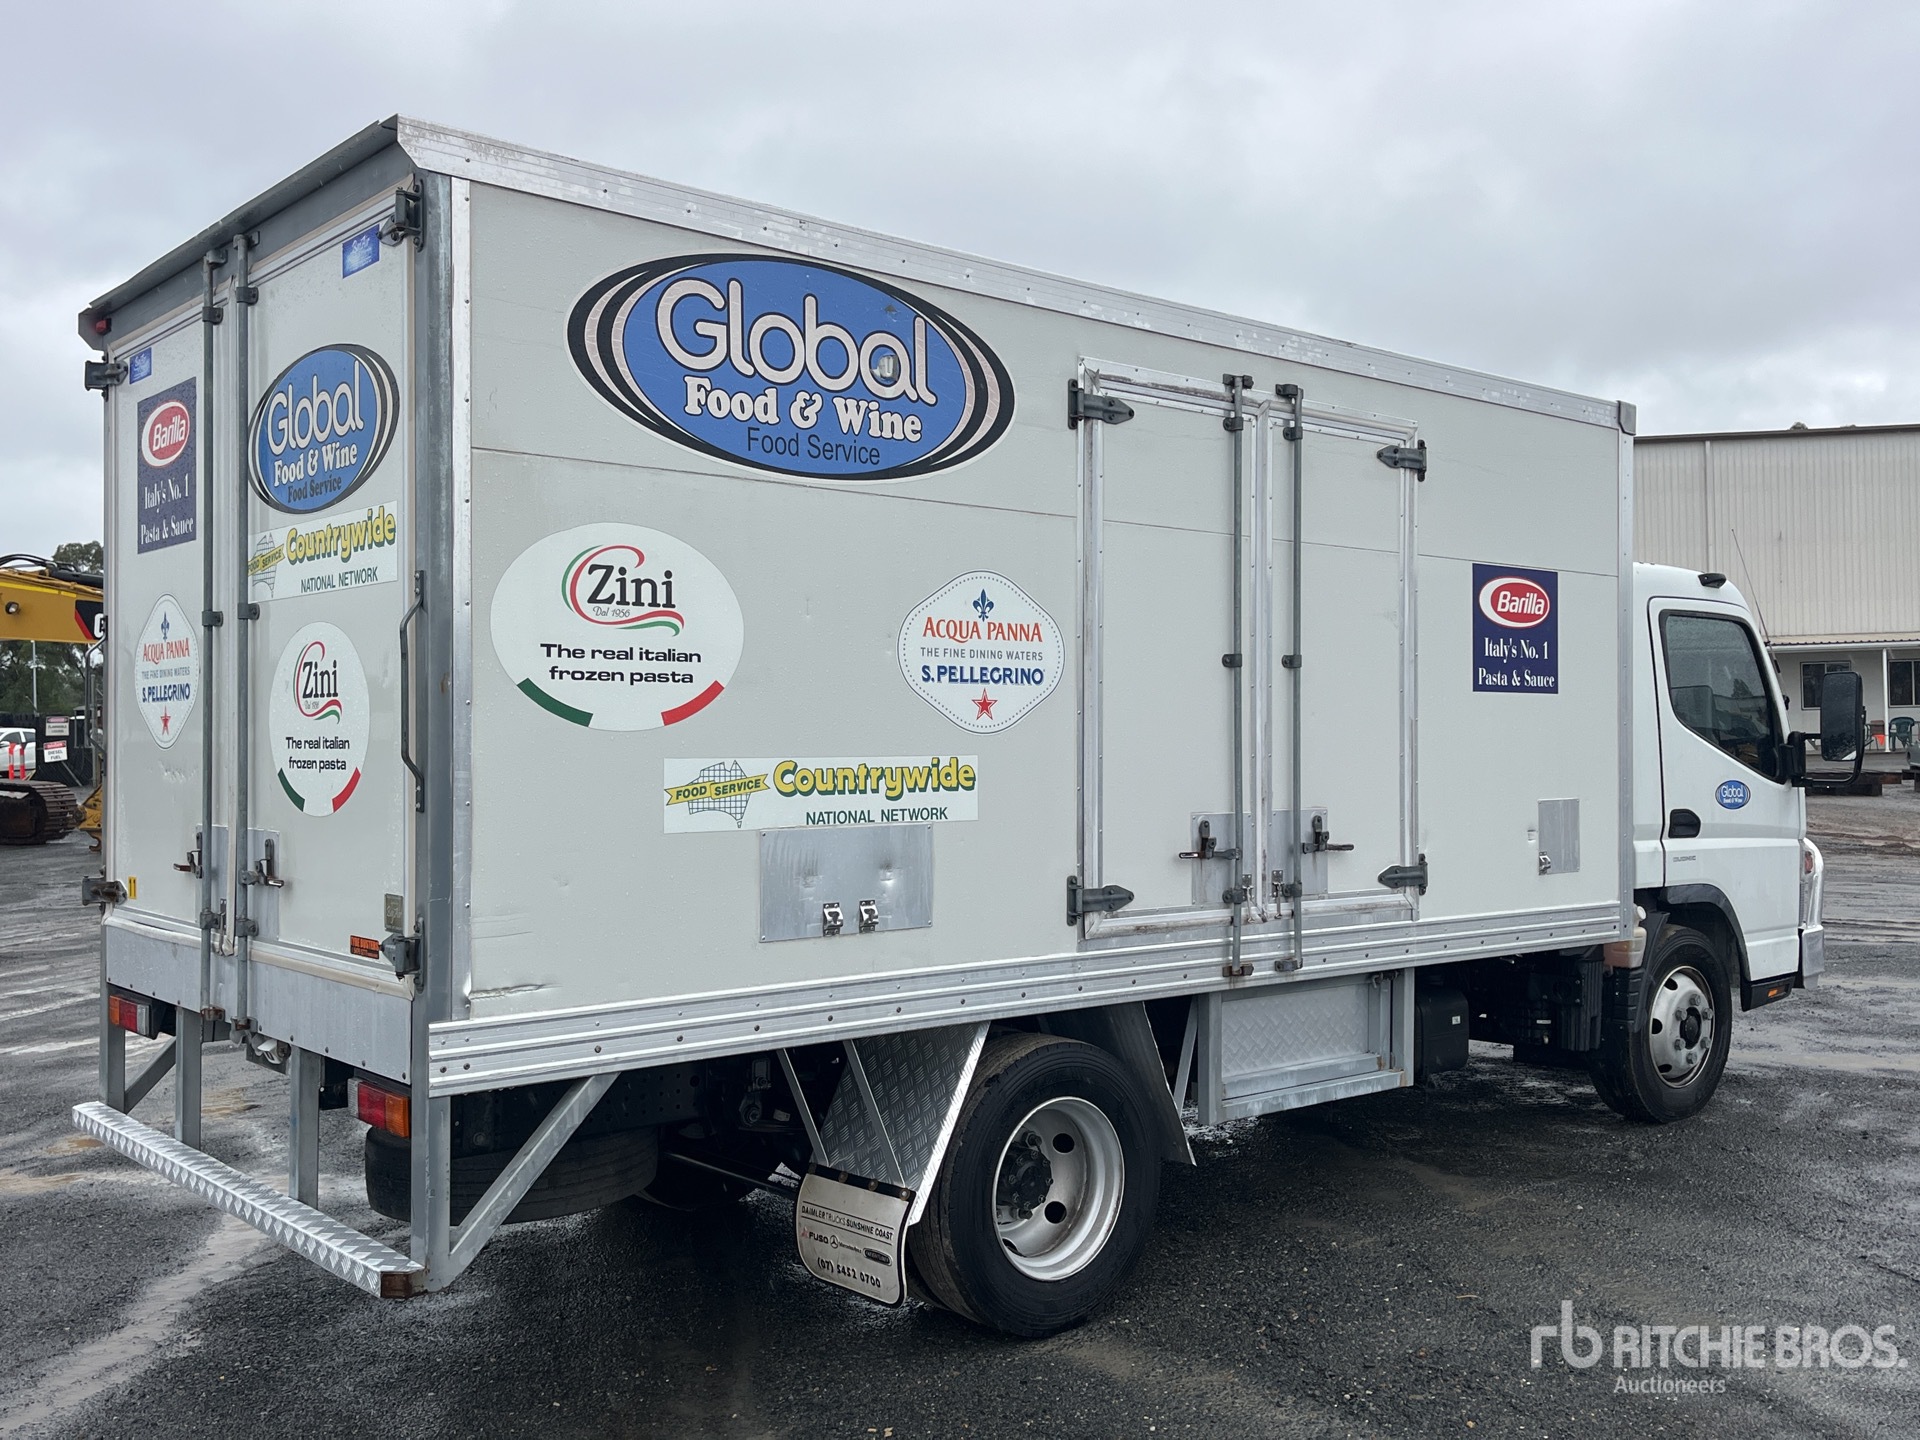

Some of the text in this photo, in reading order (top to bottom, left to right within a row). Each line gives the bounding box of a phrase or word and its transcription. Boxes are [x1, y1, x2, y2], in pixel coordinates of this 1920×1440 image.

[657, 277, 937, 405] Global
[267, 360, 364, 455] Global
[683, 375, 922, 443] Food & Wine
[153, 415, 186, 451] Barilla
[747, 426, 880, 466] Food Service
[274, 442, 357, 487] Food & Wine
[145, 473, 189, 513] Italy's No. 1
[288, 474, 342, 503] Food Service
[141, 515, 194, 544] Pasta & Sauce
[287, 505, 396, 565] Countrywide
[262, 549, 281, 568] SERVICE
[301, 566, 378, 593] NATIONAL NETWORK
[587, 564, 676, 608] Zini
[593, 605, 630, 618] Dal 1956
[1497, 590, 1545, 615] Barilla
[922, 616, 1043, 643] ACQUA PANNA
[143, 637, 190, 665] ACQUA PANNA
[540, 643, 701, 663] The real italian
[920, 647, 1043, 661] THE FINE DINING WATERS
[1484, 637, 1548, 663] Italy's No. 1
[302, 659, 338, 699] Zini
[549, 666, 694, 685] frozen pasta
[1478, 667, 1555, 687] Pasta & Sauce
[286, 736, 350, 749] The real italian
[289, 756, 346, 773] frozen pasta
[675, 778, 761, 800] FOOD SERVICE
[773, 757, 976, 802] Countrywide
[1721, 785, 1744, 798] Global
[806, 807, 948, 825] NATIONAL NETWORK
[808, 1231, 829, 1244] FUSO
[846, 1218, 874, 1236] SUNSHINE
[874, 1227, 893, 1241] COAST
[817, 1257, 881, 1288] (07) 5452 0700
